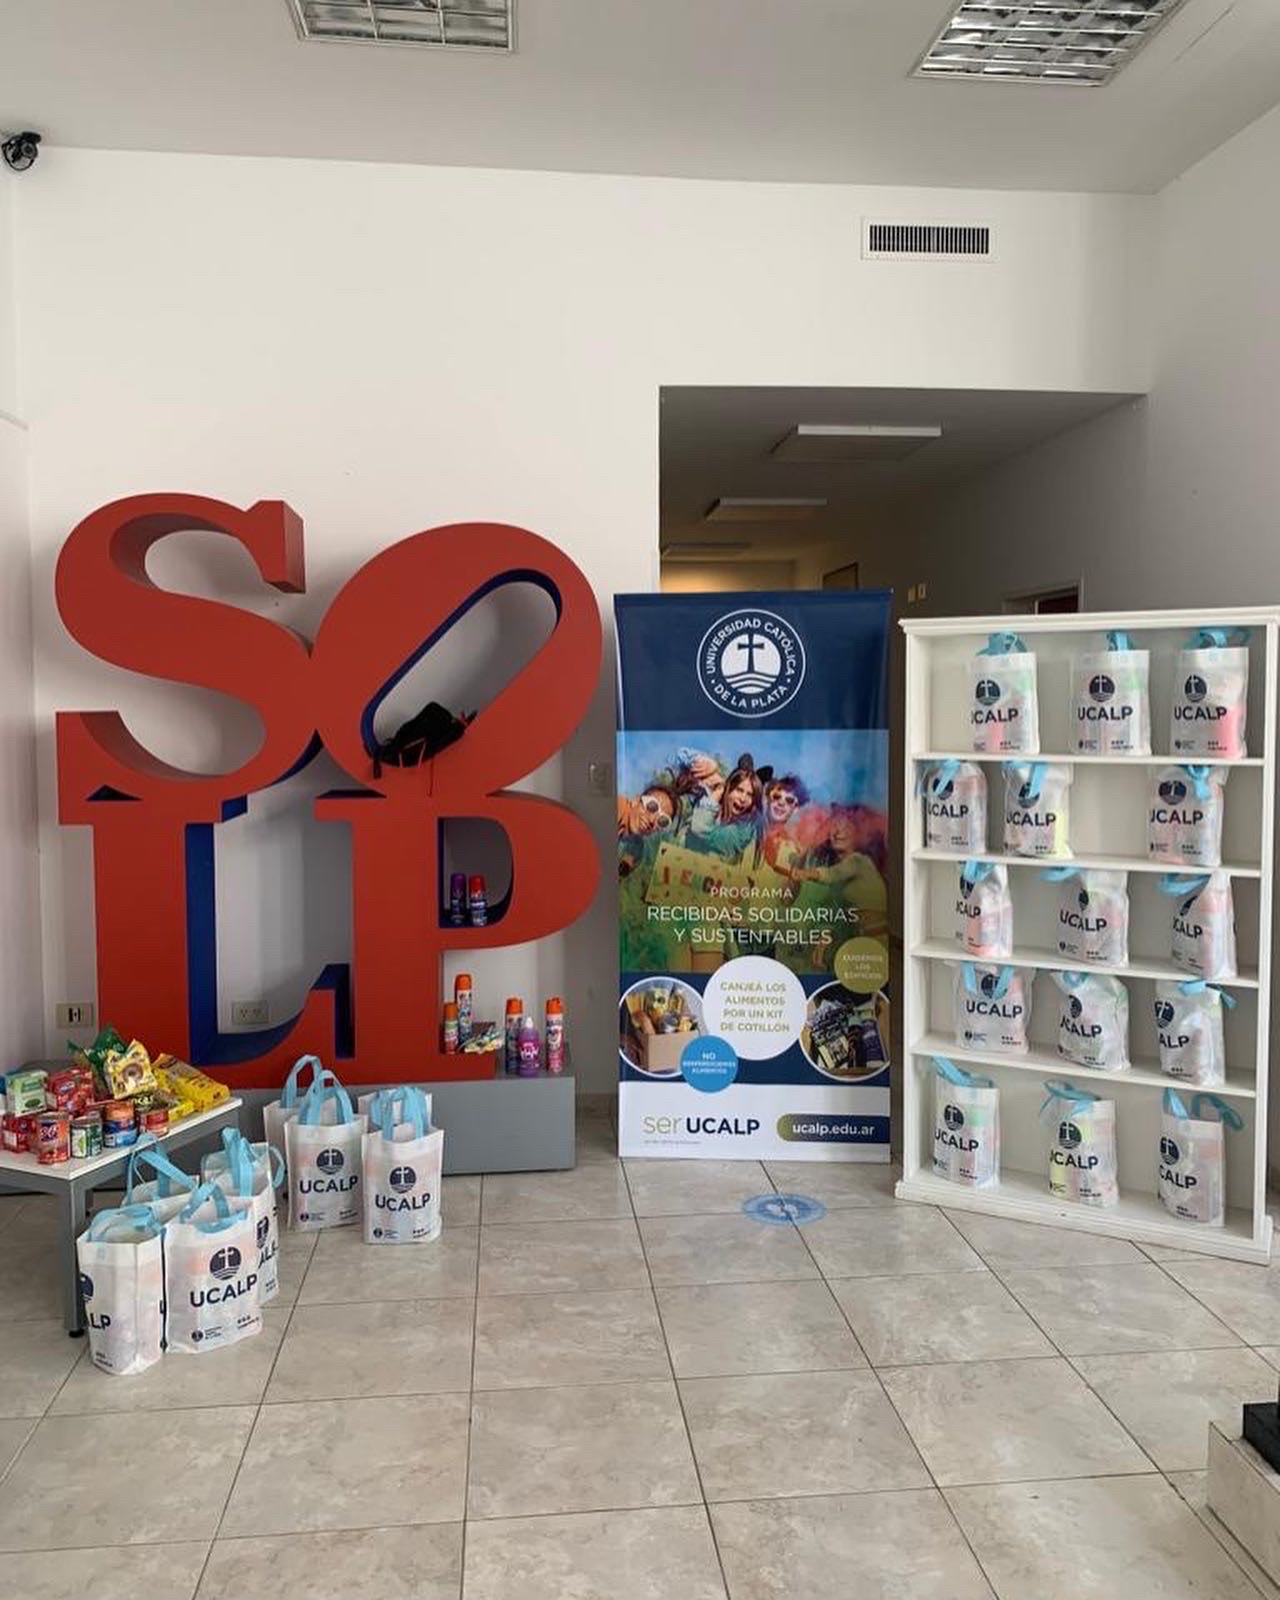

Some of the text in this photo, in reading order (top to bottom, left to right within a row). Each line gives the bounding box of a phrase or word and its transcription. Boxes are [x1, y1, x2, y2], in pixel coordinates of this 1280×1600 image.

[706, 618, 797, 675] UNIVERSIDAD CATÓLICA
[713, 683, 788, 708] DE LA PLATA
[1077, 706, 1133, 721] UCALP
[1174, 706, 1228, 721] UCALP
[710, 887, 793, 899] PROGRAMA
[647, 906, 859, 923] RECIBIDAS SOLIDARIAS
[674, 928, 833, 945] Y SUSTENTABLES
[765, 983, 787, 992] LOS
[725, 996, 786, 1006] ALIMENTOS
[723, 1008, 784, 1019] POR UN KIT
[966, 1000, 1023, 1019] UCALP
[720, 1022, 734, 1031] DE
[702, 1052, 716, 1061] NO
[644, 1116, 760, 1136] ser UCALP
[792, 1123, 875, 1137] ucalp.edu.ar
[299, 1174, 358, 1194] UCALP
[375, 1192, 431, 1211] UCALP
[189, 1273, 258, 1308] UCALP
